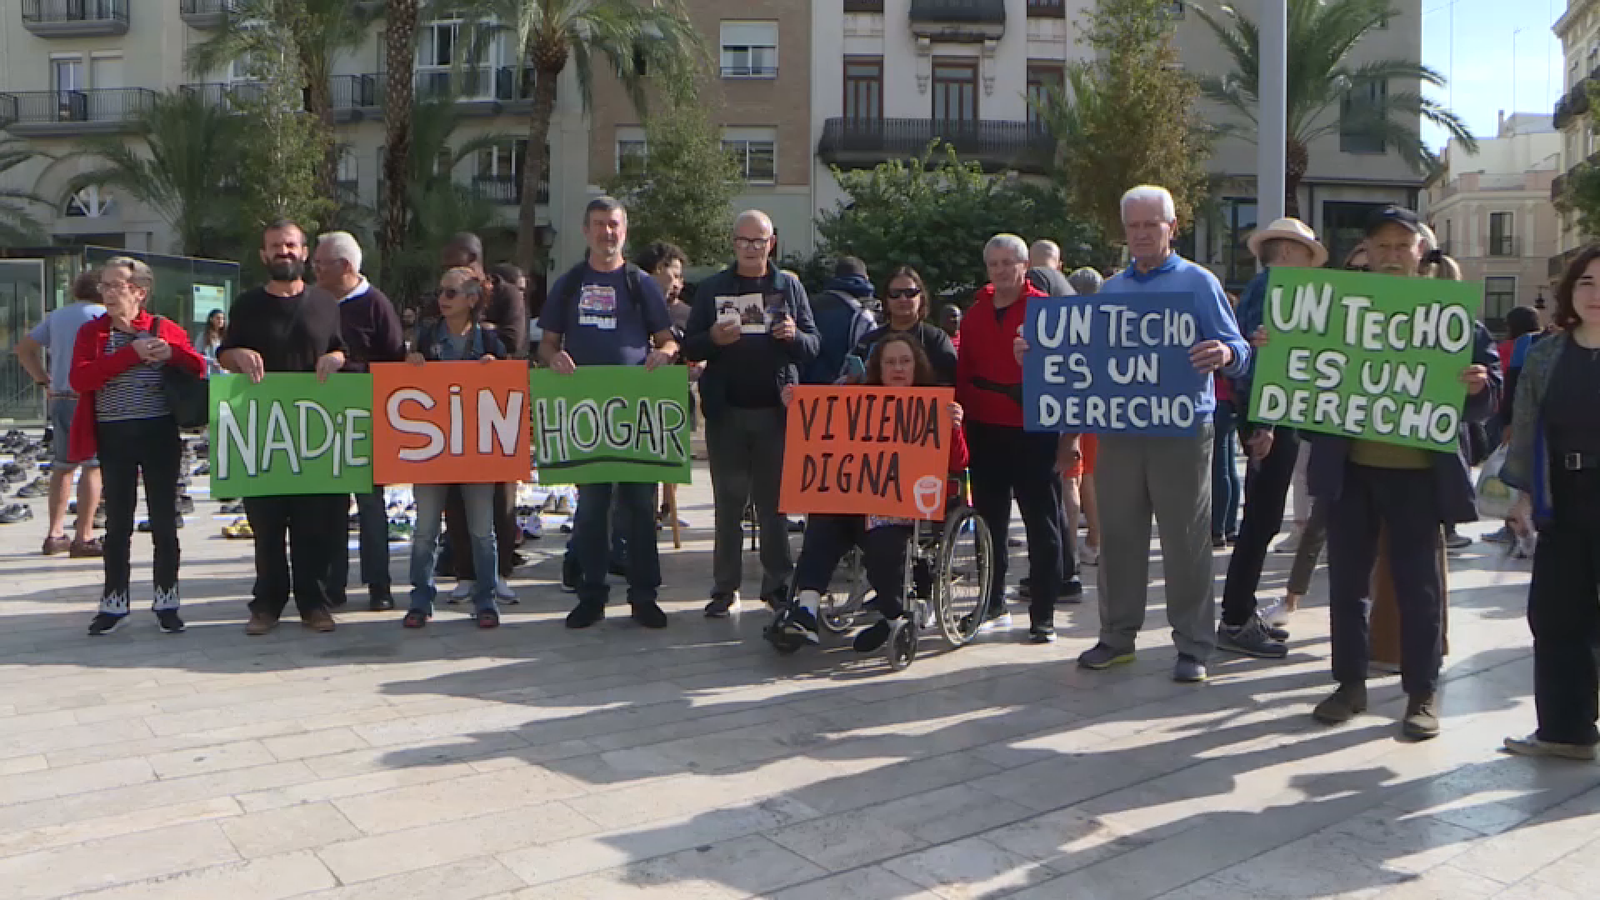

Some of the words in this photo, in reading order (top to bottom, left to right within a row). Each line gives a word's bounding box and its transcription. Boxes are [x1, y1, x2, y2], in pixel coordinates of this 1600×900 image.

[1037, 305, 1093, 348] UN
[1100, 305, 1196, 348] TECHO
[1271, 282, 1332, 335] UN
[1341, 296, 1471, 353] TECHO
[1044, 352, 1093, 390] ES
[1107, 352, 1160, 385] UN
[1289, 349, 1348, 389] ES
[1361, 361, 1426, 397] UN
[536, 396, 687, 464] HOGAR
[798, 394, 941, 450] VIVIENDA
[1039, 394, 1194, 429] DERECHO
[1258, 384, 1458, 443] DERECHO
[800, 451, 902, 503] DIGNA
